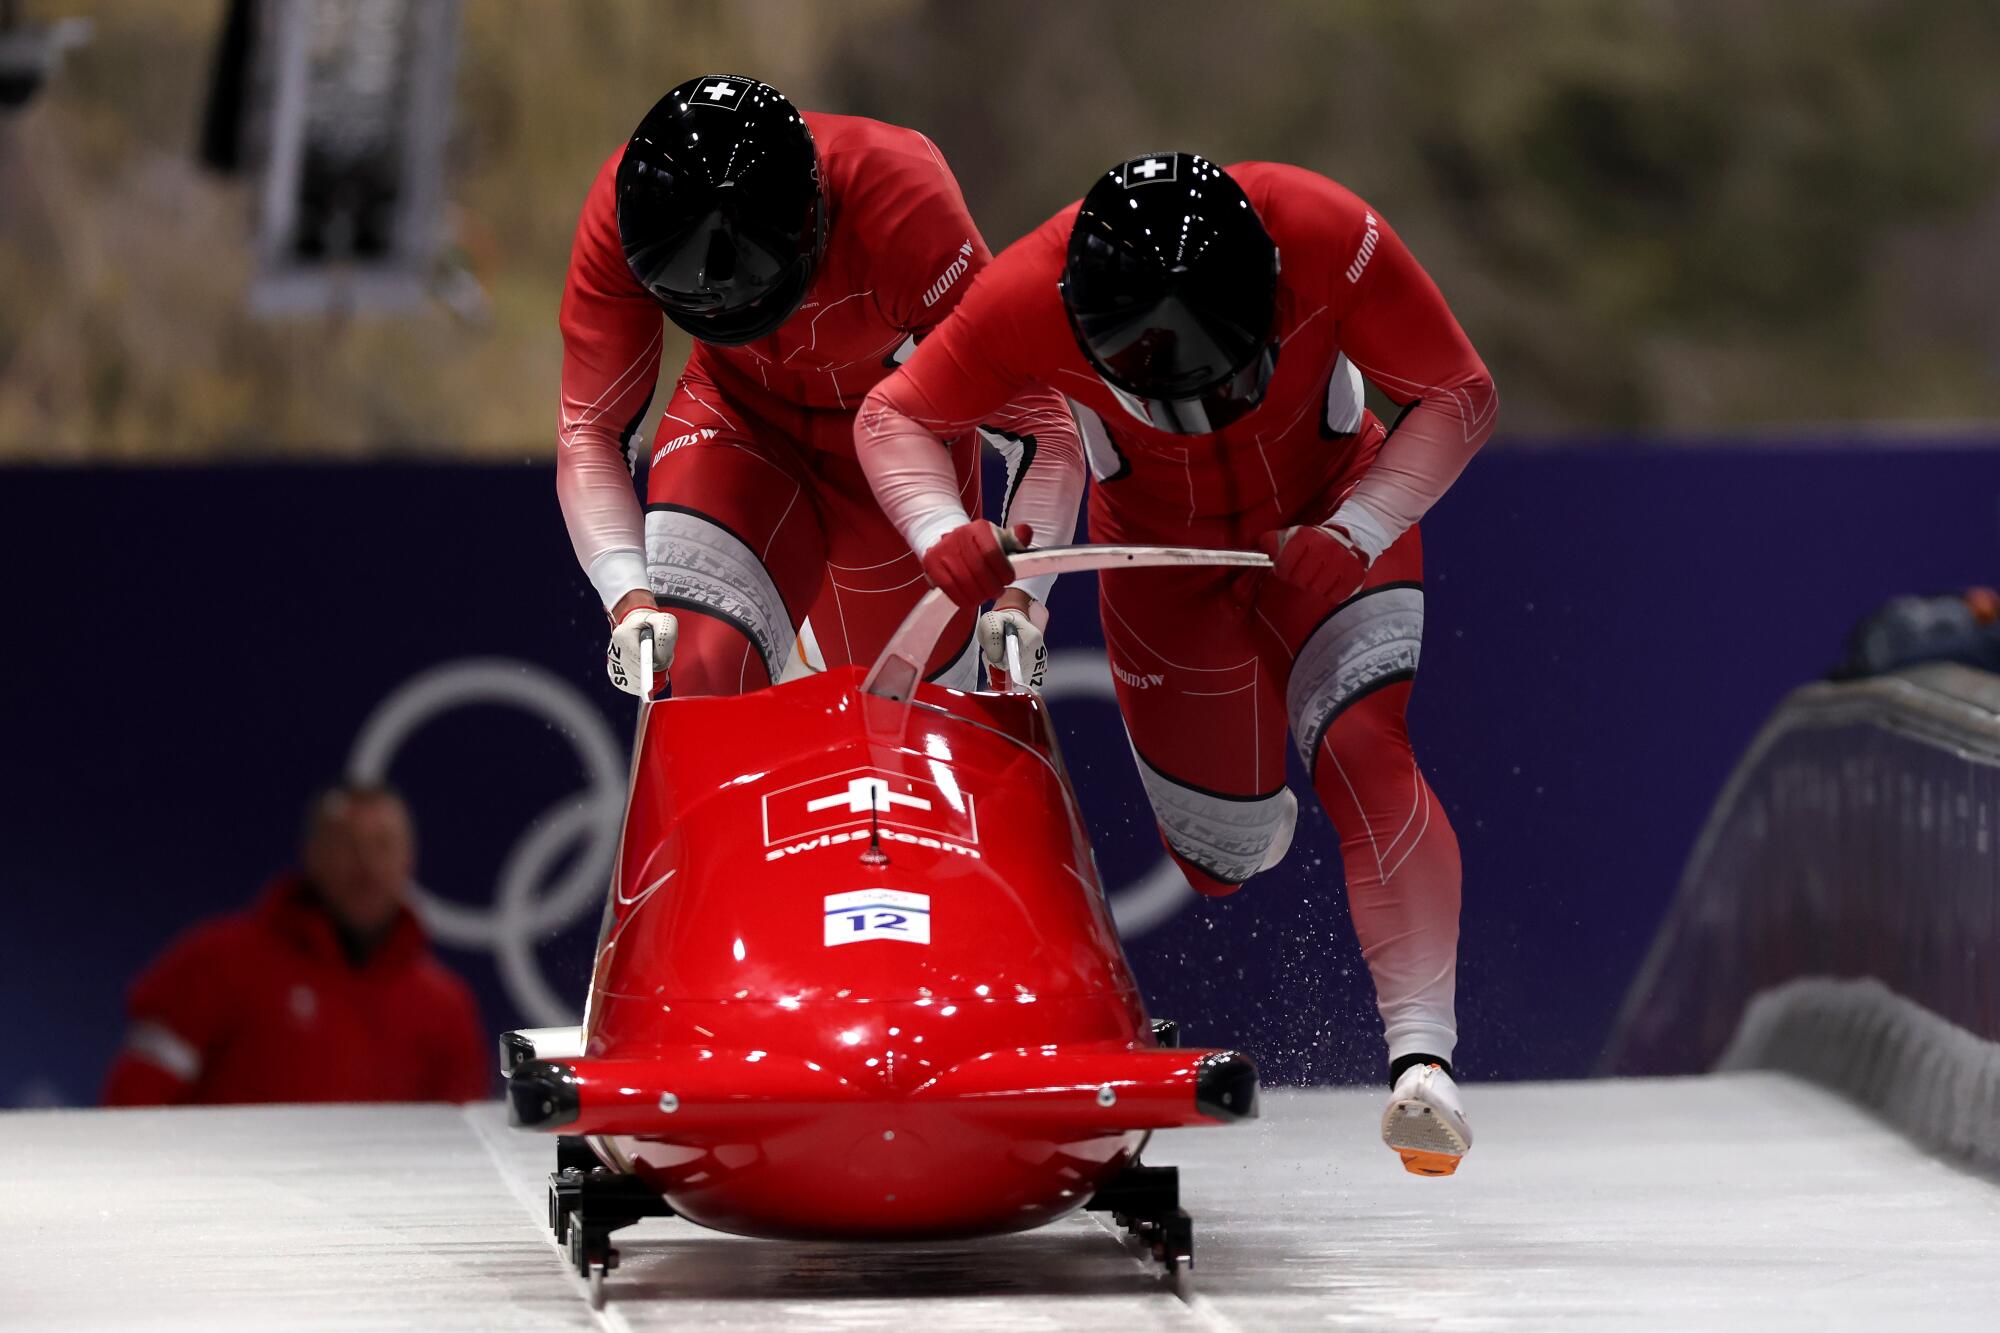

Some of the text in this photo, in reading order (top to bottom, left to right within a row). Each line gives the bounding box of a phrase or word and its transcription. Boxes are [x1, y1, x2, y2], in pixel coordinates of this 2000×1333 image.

[800, 301, 820, 310] eam
[608, 642, 628, 687] SEIZ
[1030, 645, 1048, 687] SEIZ
[765, 828, 981, 862] swiss team
[846, 912, 909, 932] 12
